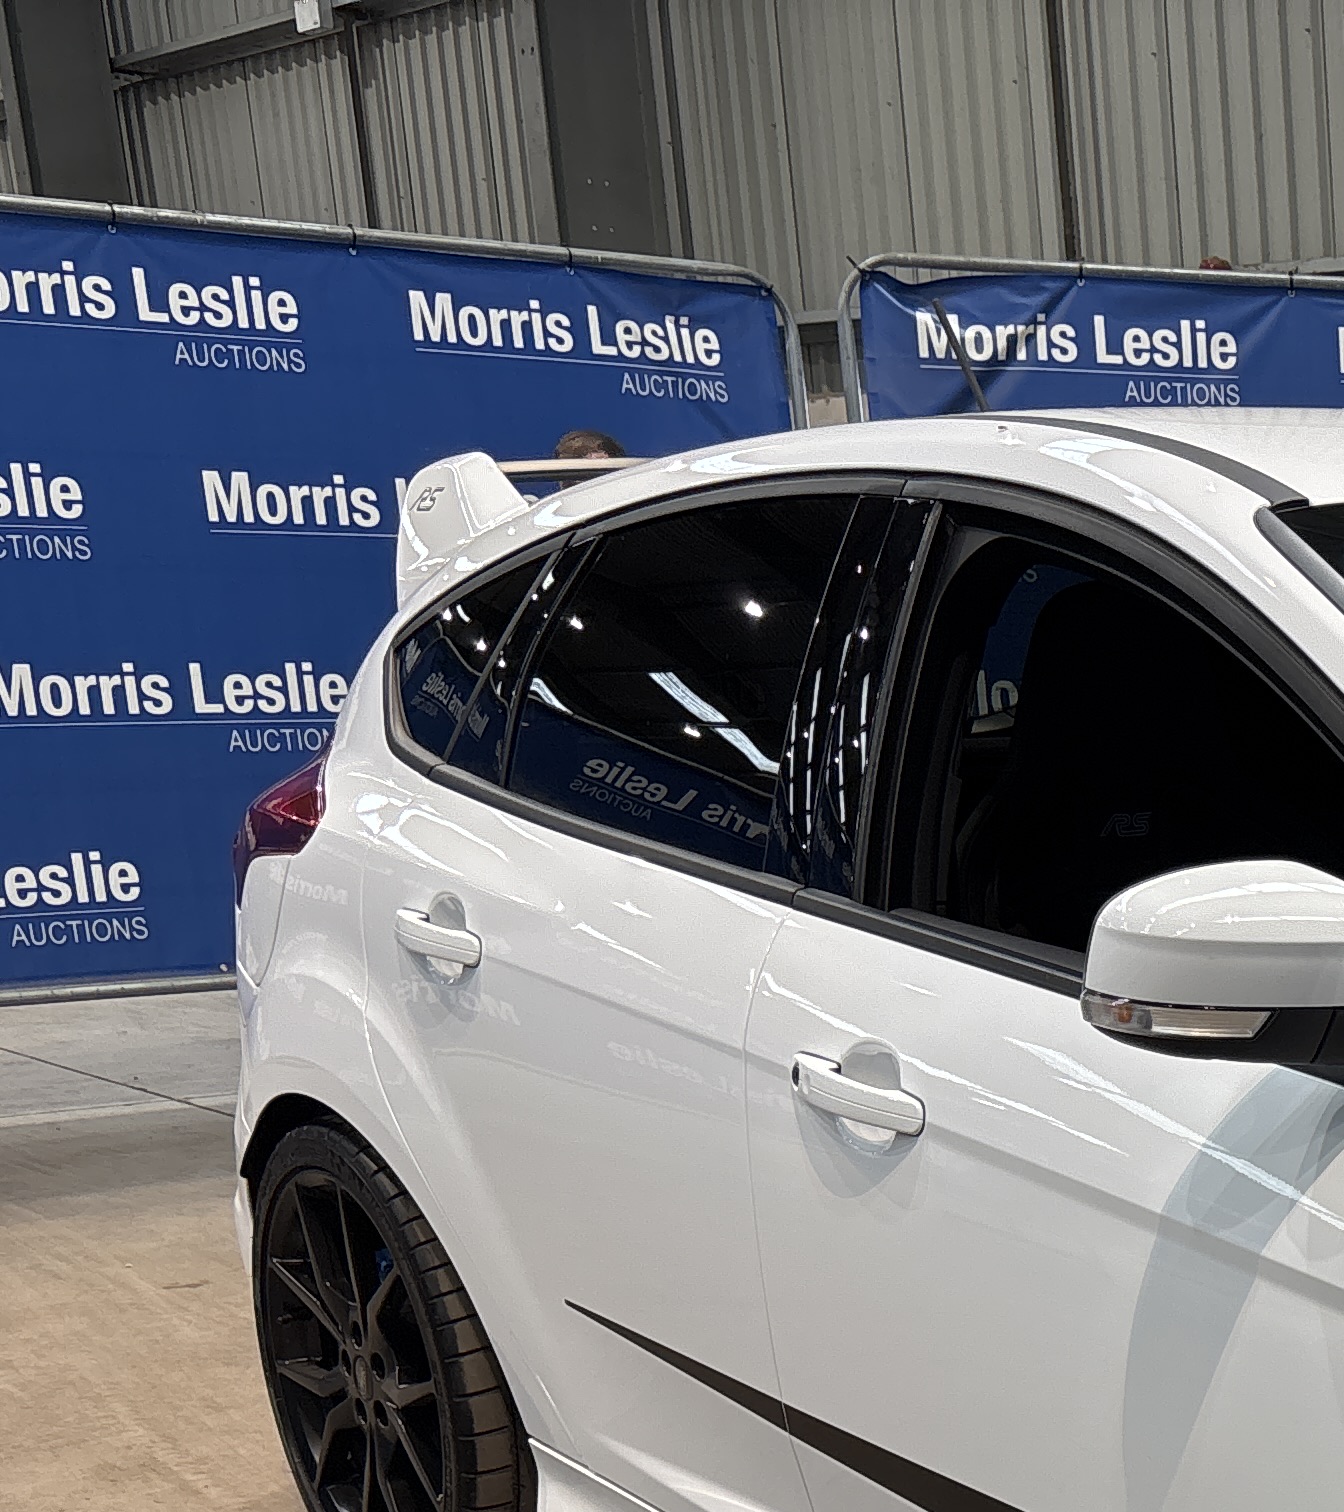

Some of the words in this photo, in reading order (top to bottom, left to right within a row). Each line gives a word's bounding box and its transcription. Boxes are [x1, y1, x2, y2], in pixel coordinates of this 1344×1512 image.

[0, 261, 115, 319] rris
[132, 267, 298, 334] Leslie
[409, 290, 573, 353] Morris
[587, 305, 720, 369] Leslie
[914, 312, 1077, 363] Morris
[1094, 315, 1237, 369] Leslie
[175, 342, 305, 372] AUCTIONS
[622, 373, 728, 402] AUCTIONS
[1125, 381, 1240, 405] AUCTIONS
[202, 470, 380, 527] Morris
[0, 663, 172, 716] Morris
[189, 662, 349, 714] Leslie
[229, 728, 334, 753] AUCTIO
[0, 851, 140, 911] eslie
[12, 917, 148, 947] AUCTIONS
